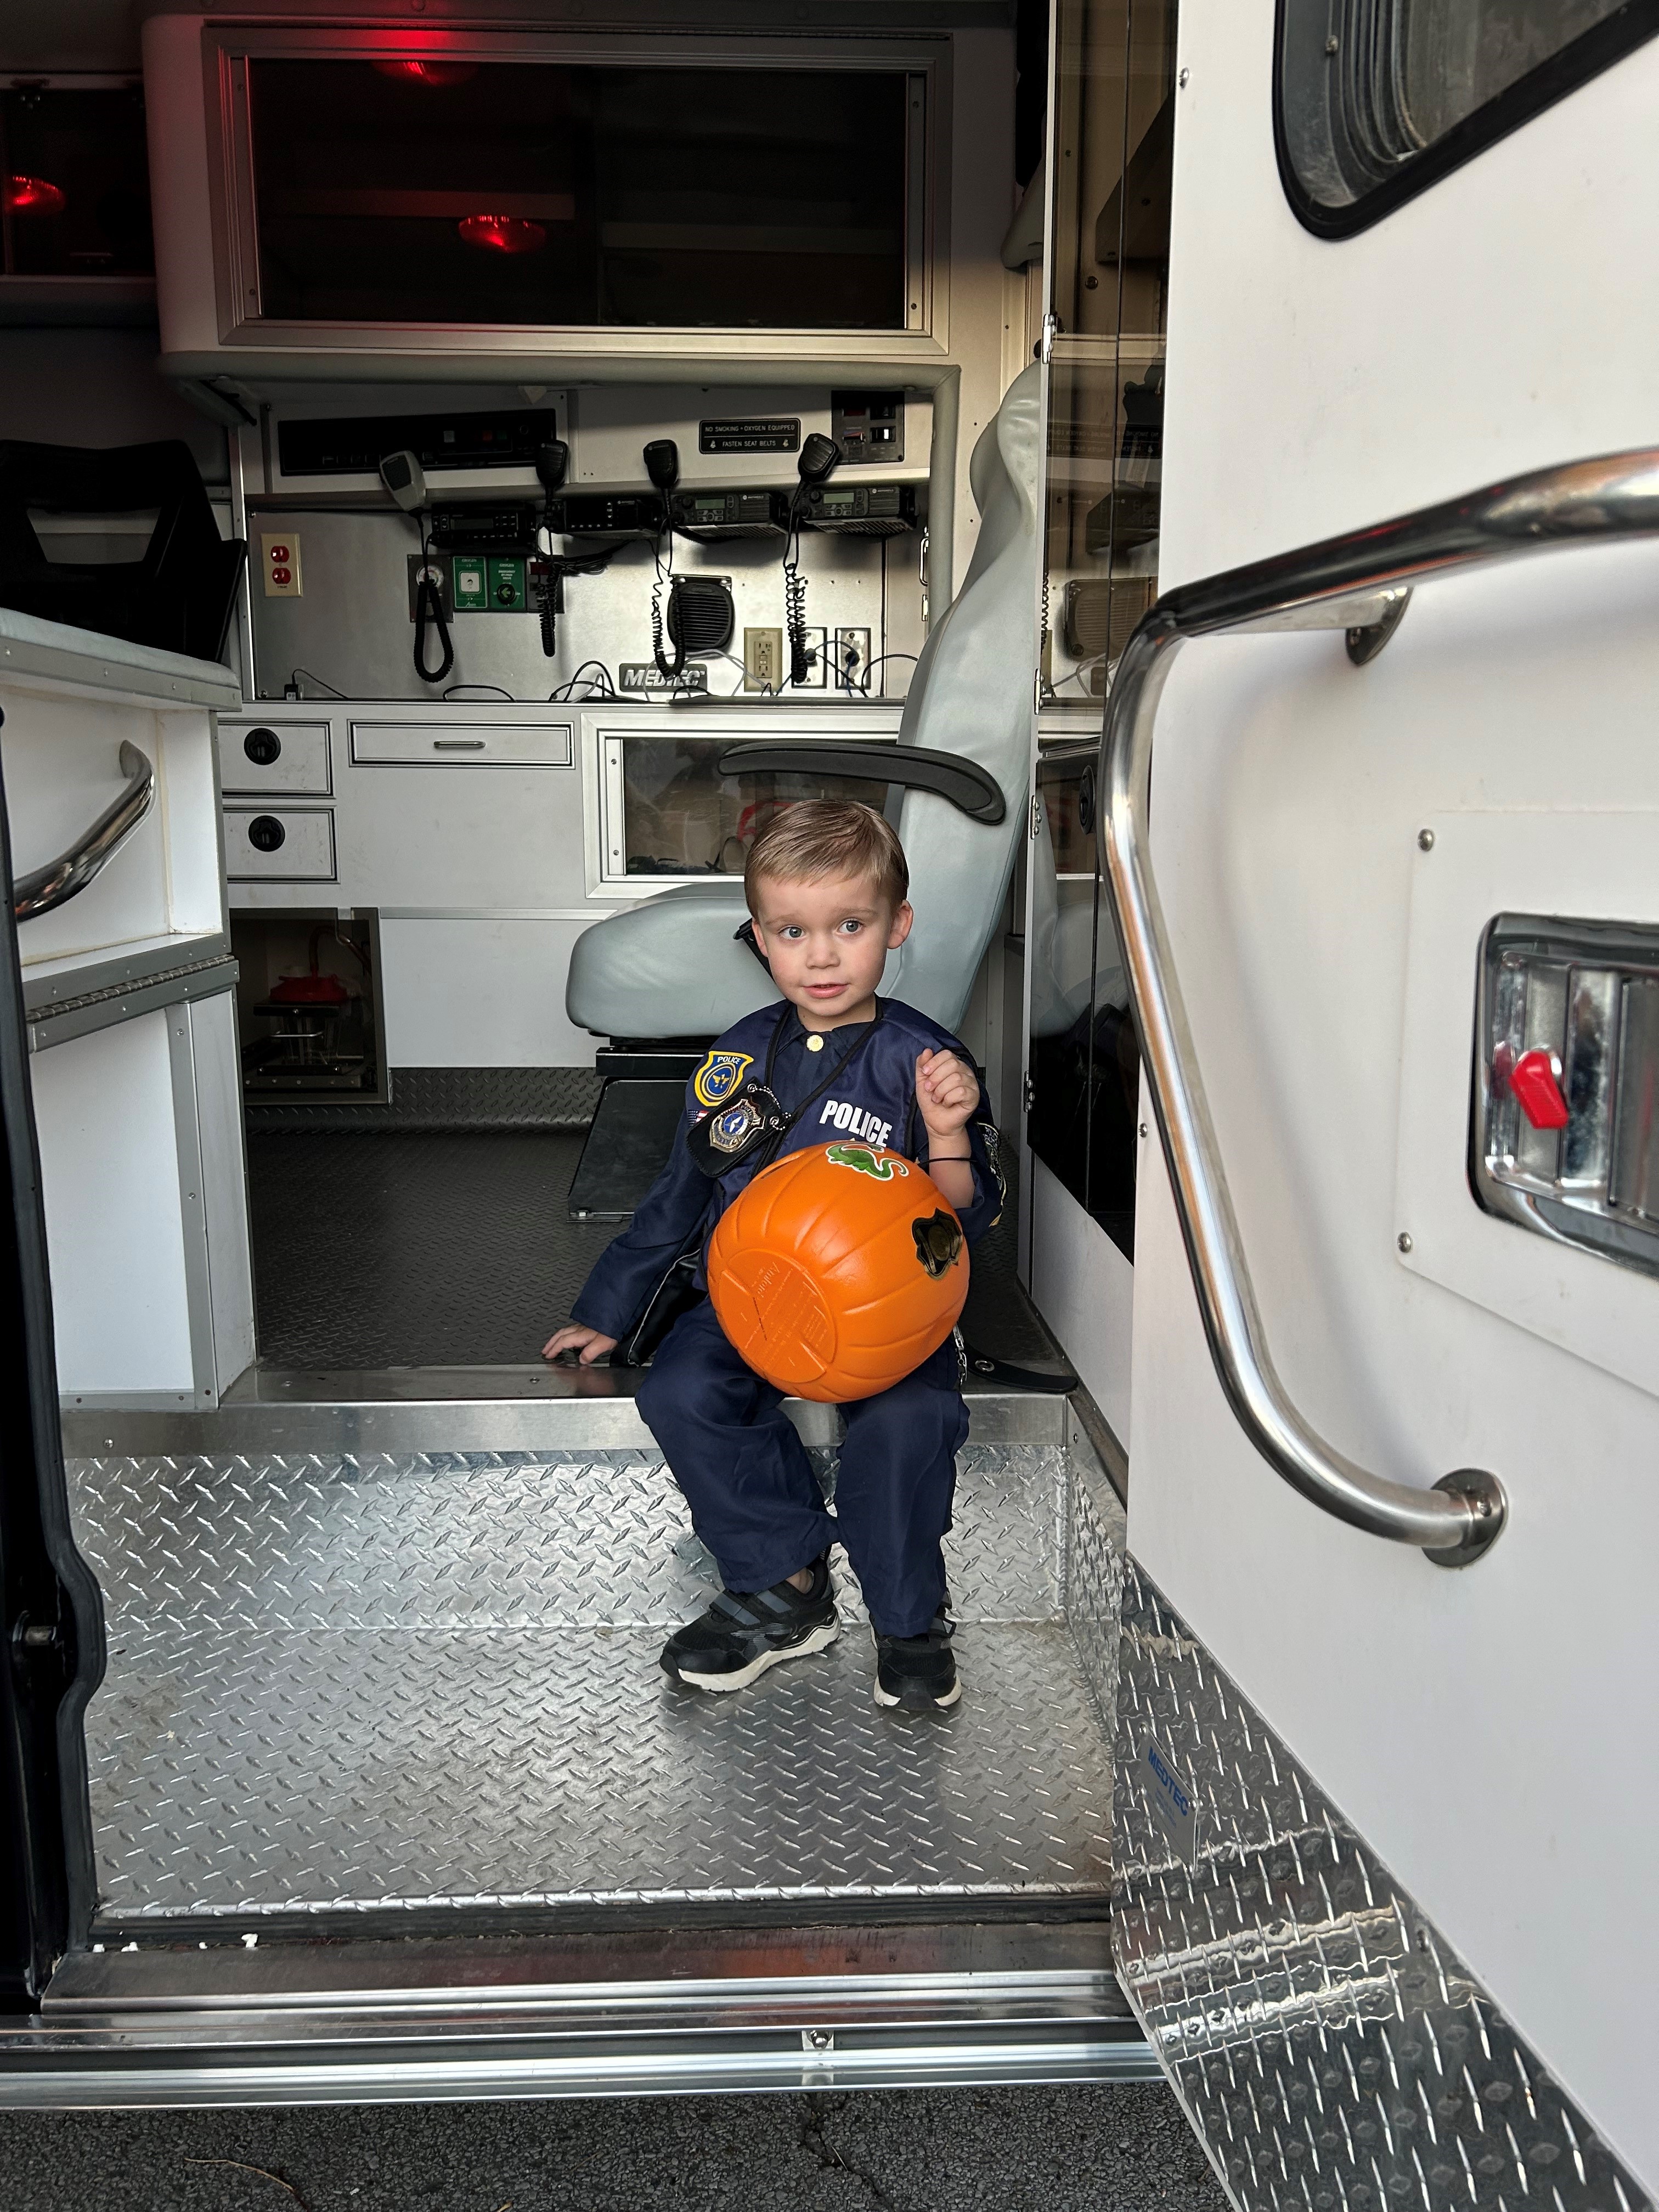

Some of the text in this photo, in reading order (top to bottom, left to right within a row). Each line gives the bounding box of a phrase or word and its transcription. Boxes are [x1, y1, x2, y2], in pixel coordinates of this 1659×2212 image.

[717, 1056, 741, 1065] POLICE
[819, 1099, 893, 1148] POLICE
[1148, 1746, 1189, 1817] MEDTEC
